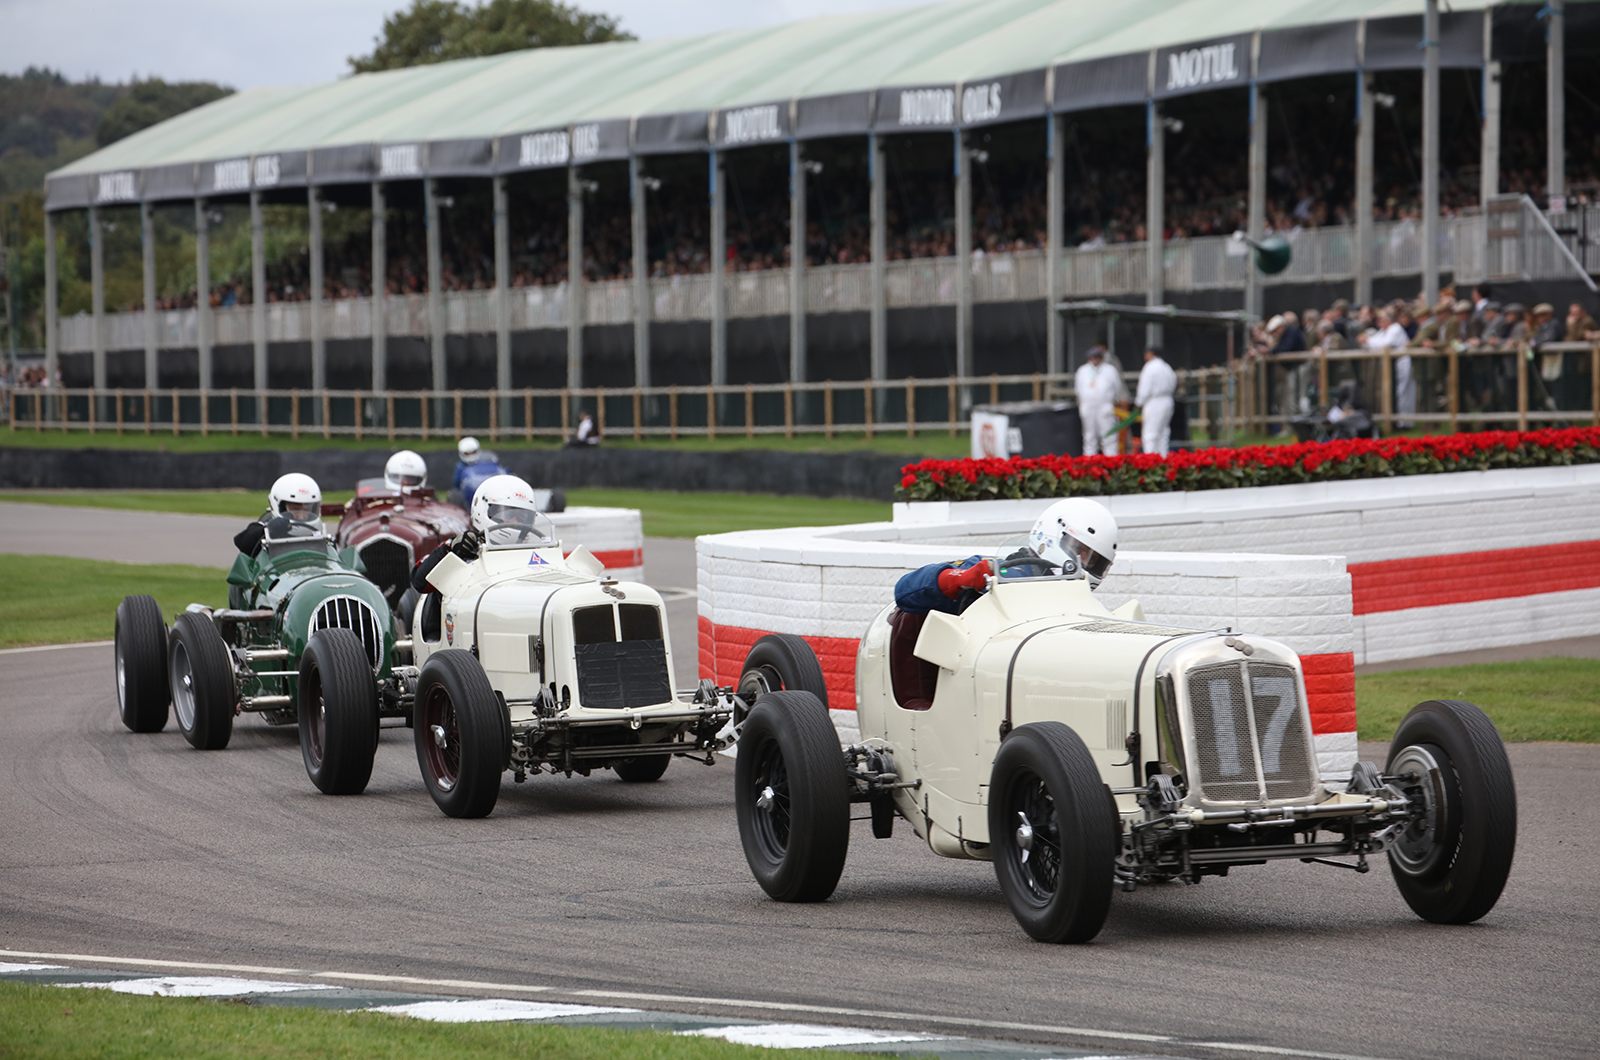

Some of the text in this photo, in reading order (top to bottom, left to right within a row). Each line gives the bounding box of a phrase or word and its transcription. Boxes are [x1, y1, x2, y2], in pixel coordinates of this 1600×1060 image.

[1166, 42, 1239, 90] MOTUL
[725, 105, 781, 144] MOTUL
[899, 82, 1002, 125] MOTOR OILS
[1207, 677, 1297, 776] 17
